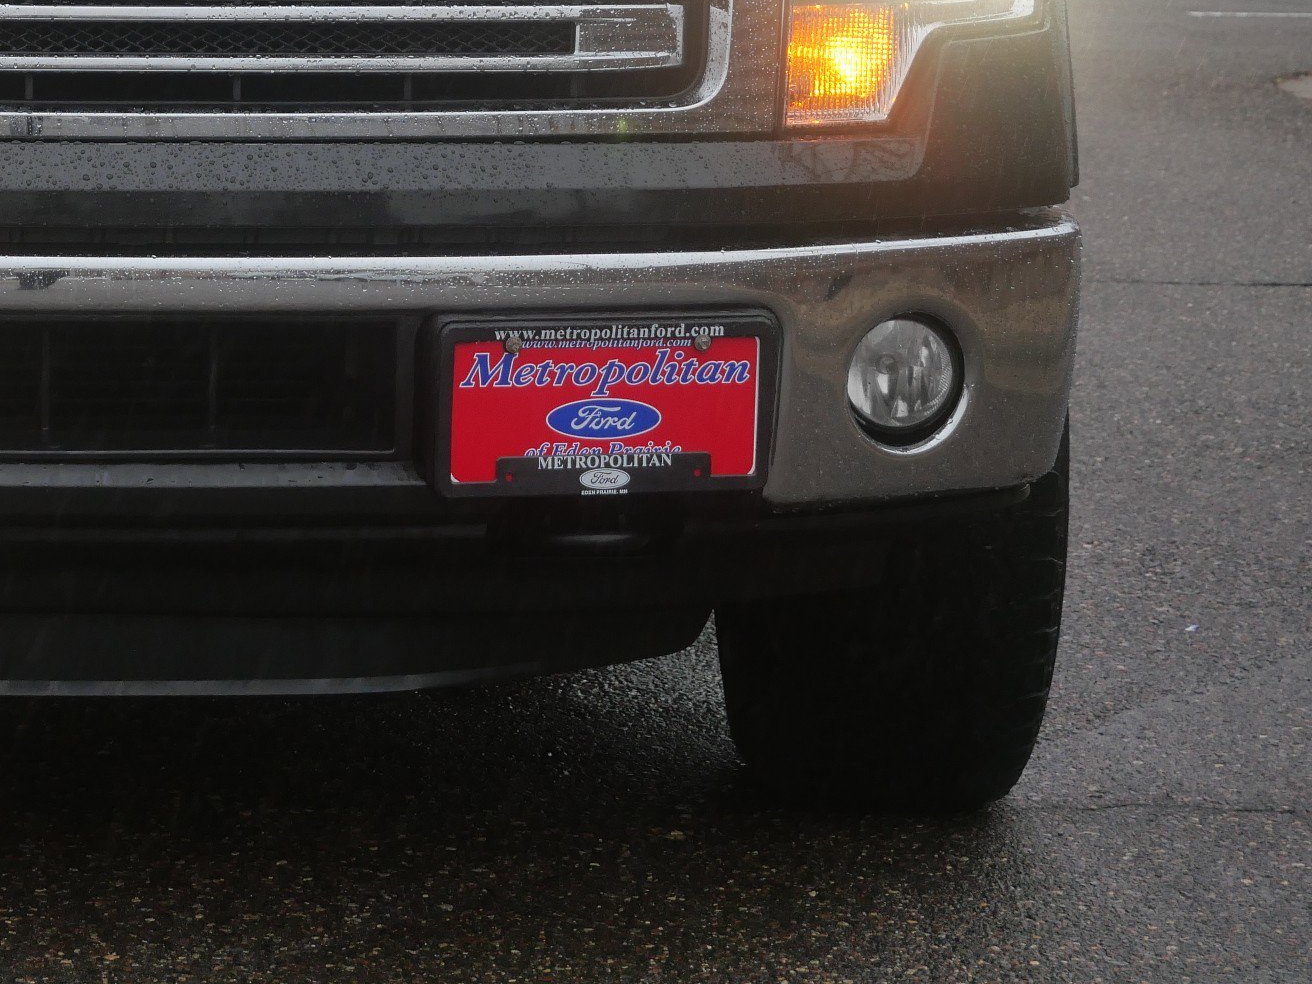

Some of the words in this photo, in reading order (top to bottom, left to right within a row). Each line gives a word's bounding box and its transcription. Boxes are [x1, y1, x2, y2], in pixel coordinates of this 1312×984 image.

[494, 323, 725, 343] www.metropolitanford.com
[459, 348, 750, 397] Metropolitan
[570, 405, 635, 431] Ford
[538, 453, 673, 470] METROPOLITAN
[590, 471, 620, 484] Ford
